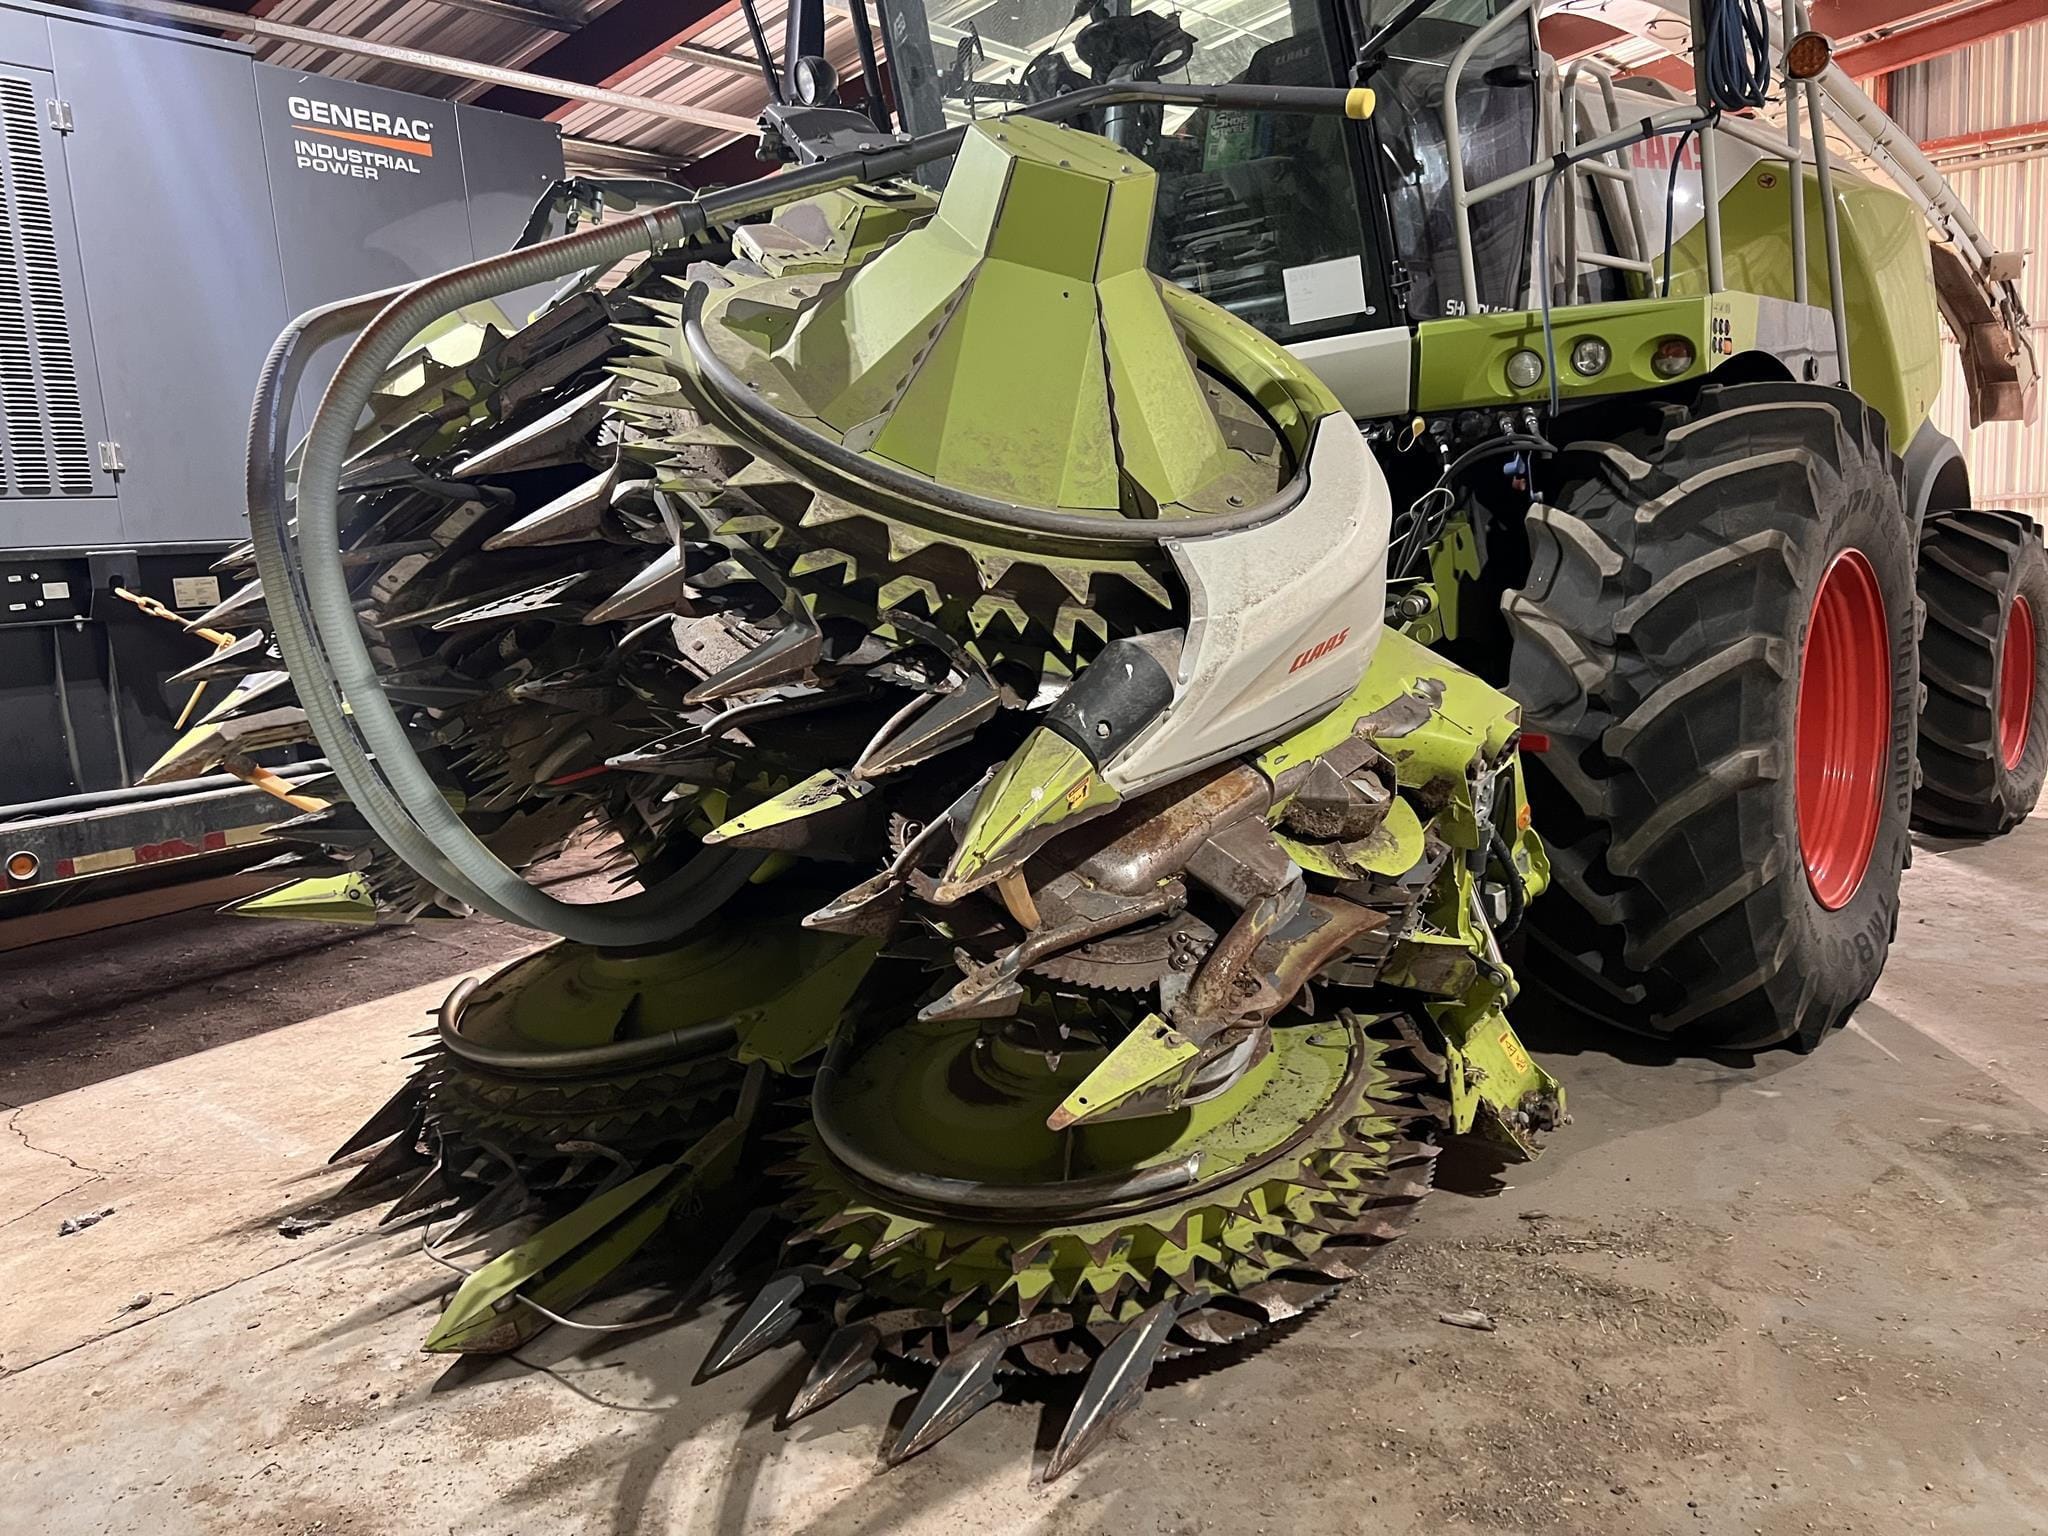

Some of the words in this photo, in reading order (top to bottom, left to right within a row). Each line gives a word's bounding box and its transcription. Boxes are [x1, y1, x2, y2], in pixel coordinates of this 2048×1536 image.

[288, 96, 431, 142] GENERAC
[294, 139, 420, 174] INDUSTRIAL
[296, 156, 379, 180] POWER
[1288, 626, 1351, 674] CLAAS
[1893, 600, 1914, 813] TRELLEBORG
